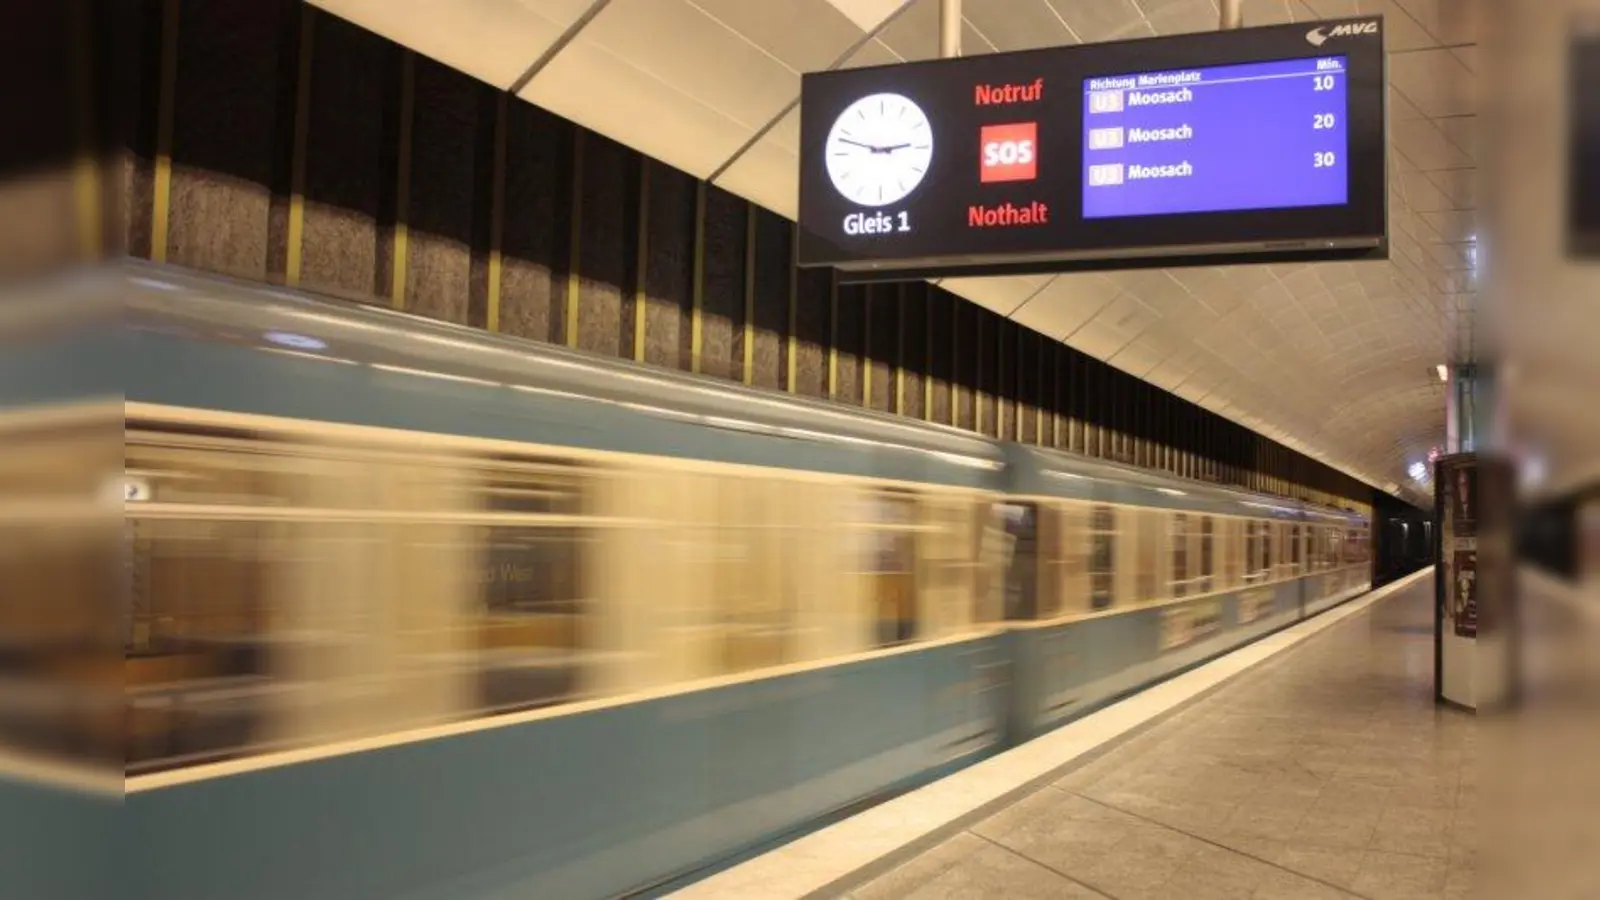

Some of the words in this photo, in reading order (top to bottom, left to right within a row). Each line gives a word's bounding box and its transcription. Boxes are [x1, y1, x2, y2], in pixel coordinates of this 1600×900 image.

[1328, 21, 1378, 36] MVG
[1316, 57, 1342, 70] Min.
[975, 78, 1044, 105] Notruf
[1090, 77, 1136, 90] Richtung
[1138, 72, 1201, 87] Marienplatz
[1128, 87, 1193, 106] Moosach
[1313, 75, 1334, 91] 10
[1128, 123, 1193, 143] Moosach
[1313, 114, 1335, 129] 20
[983, 139, 1033, 167] SOS
[1128, 159, 1193, 179] Moosach
[1313, 152, 1335, 168] 30
[843, 211, 892, 235] Gleis
[897, 211, 911, 232] 1
[968, 201, 1048, 227] Nothalt
